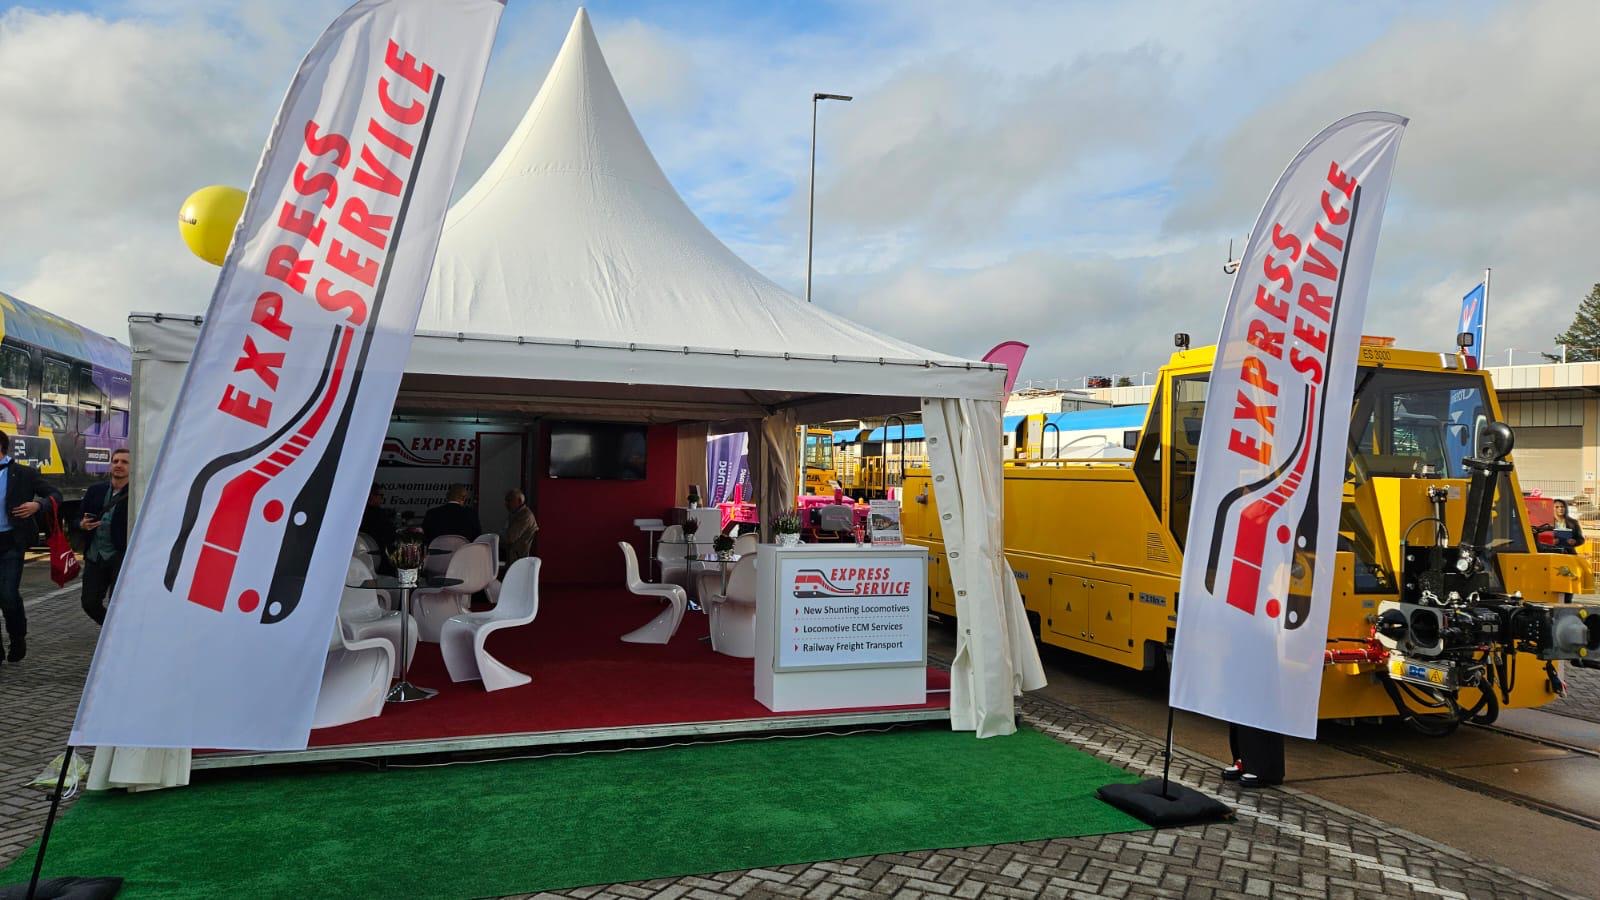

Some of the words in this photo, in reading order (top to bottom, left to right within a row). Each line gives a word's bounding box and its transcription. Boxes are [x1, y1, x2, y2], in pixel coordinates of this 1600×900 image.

[315, 38, 434, 326] SERVICE
[217, 119, 352, 428] EXPRESS
[1289, 160, 1359, 386] SERVICE
[1227, 223, 1302, 465] EXPRESS
[1363, 349, 1373, 360] ES
[411, 437, 476, 451] EXPRES
[441, 452, 473, 466] SER
[831, 568, 890, 580] EXPRESS
[855, 582, 910, 594] SERVICE
[803, 606, 822, 615] New
[824, 604, 860, 616] Shunting
[861, 603, 910, 613] Locomotives
[803, 624, 850, 634] Locomotive
[852, 623, 870, 632] ECM
[871, 622, 903, 631] Services
[803, 642, 834, 653] Railway
[836, 641, 864, 652] Freight
[866, 640, 903, 652] Transport
